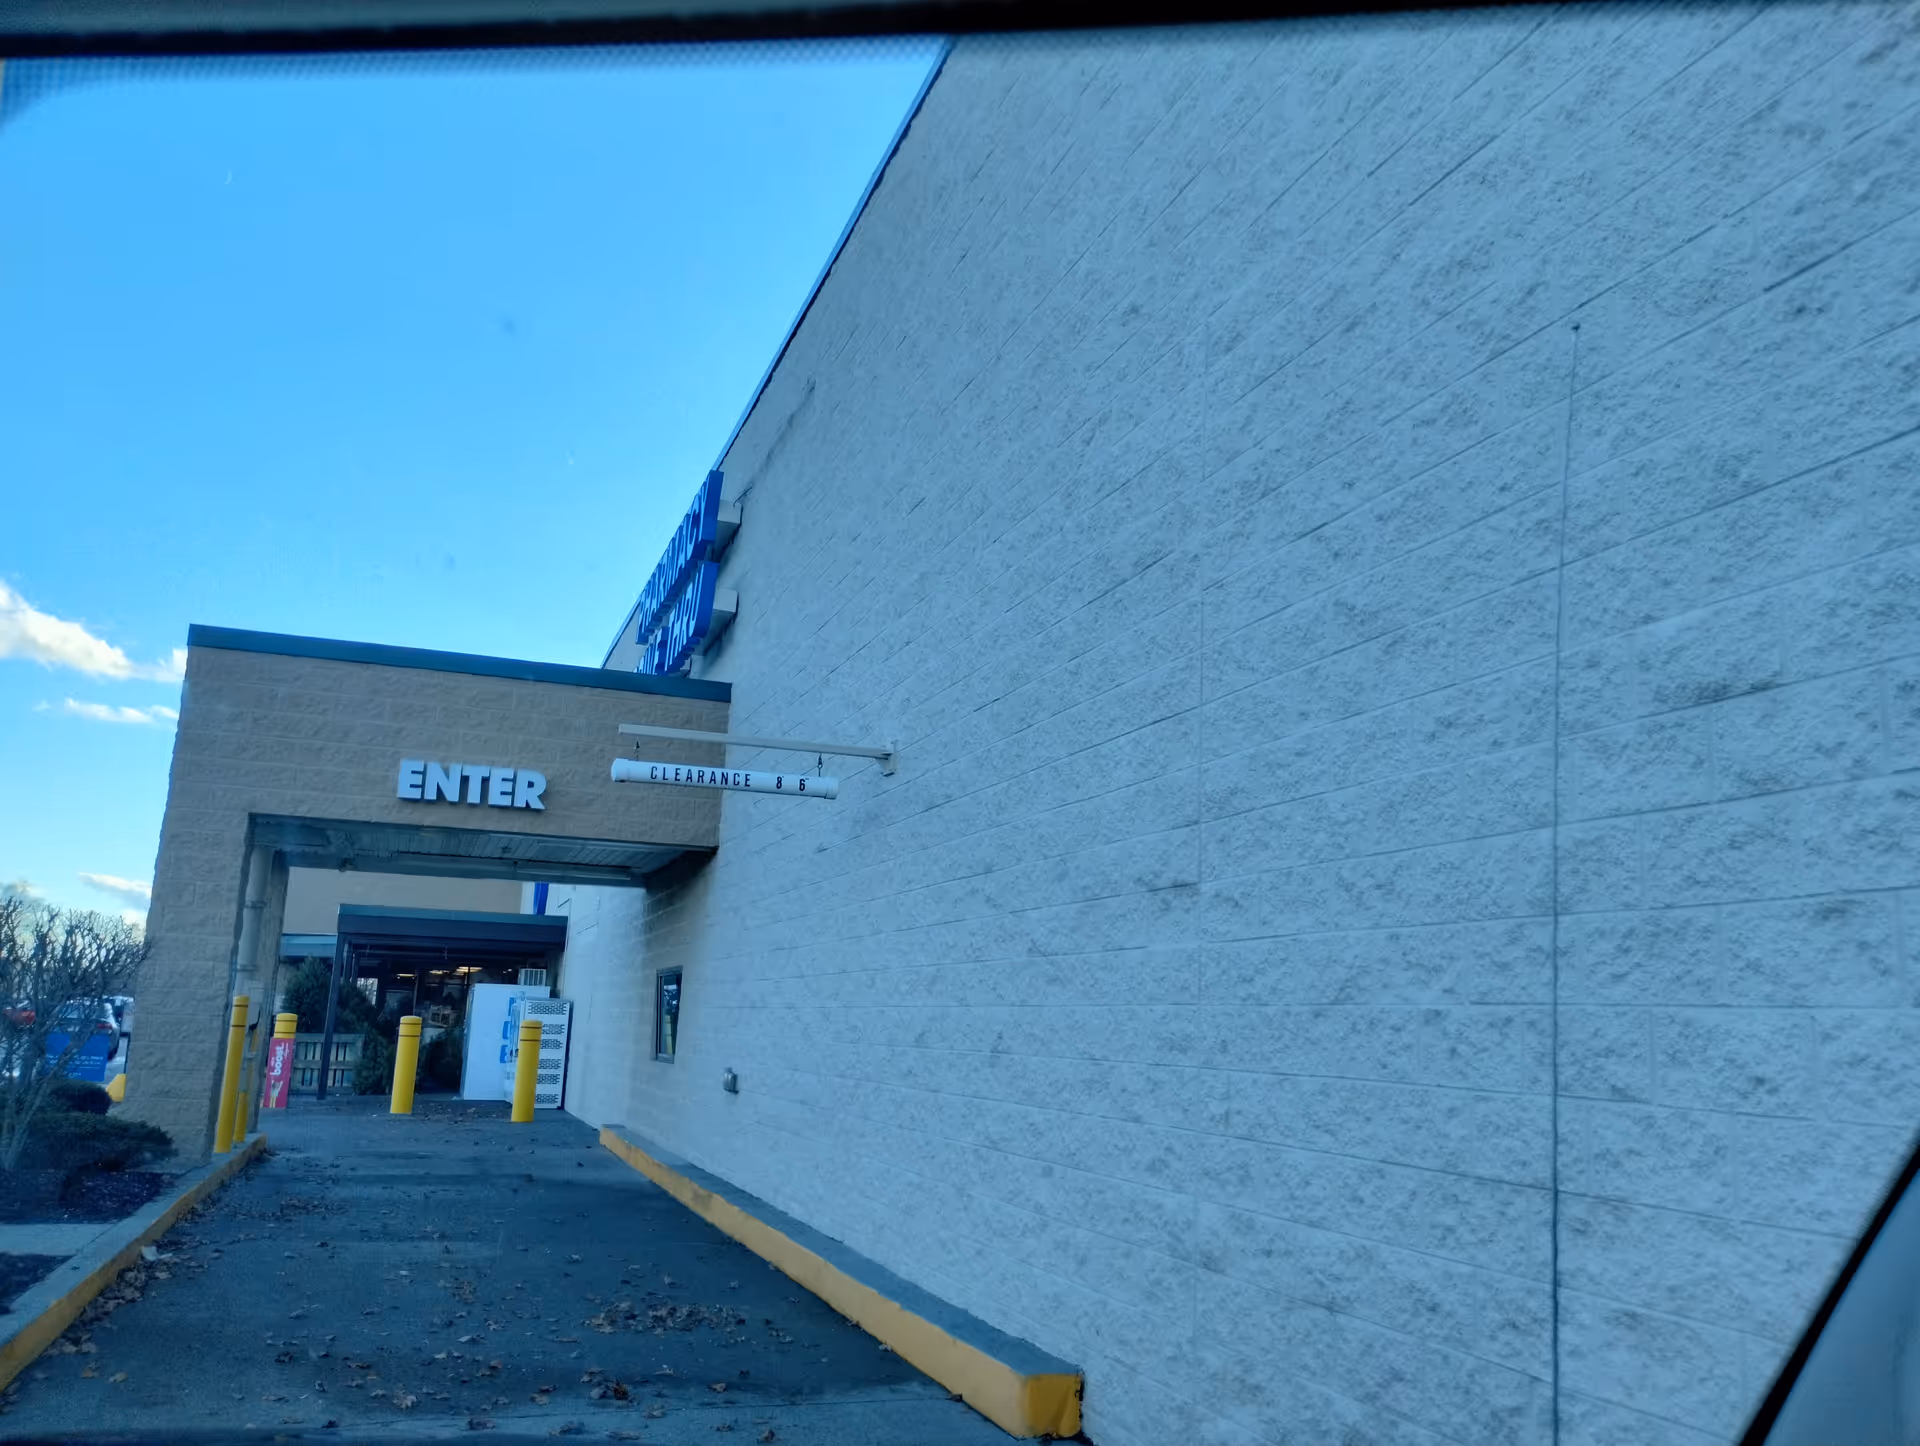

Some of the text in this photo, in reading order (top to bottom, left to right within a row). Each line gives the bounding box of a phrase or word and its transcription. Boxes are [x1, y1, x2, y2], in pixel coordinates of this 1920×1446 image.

[635, 471, 711, 644] PHARMACY
[664, 562, 704, 672] THRU
[398, 759, 547, 810] ENTER
[650, 766, 751, 788] CLEARANCE
